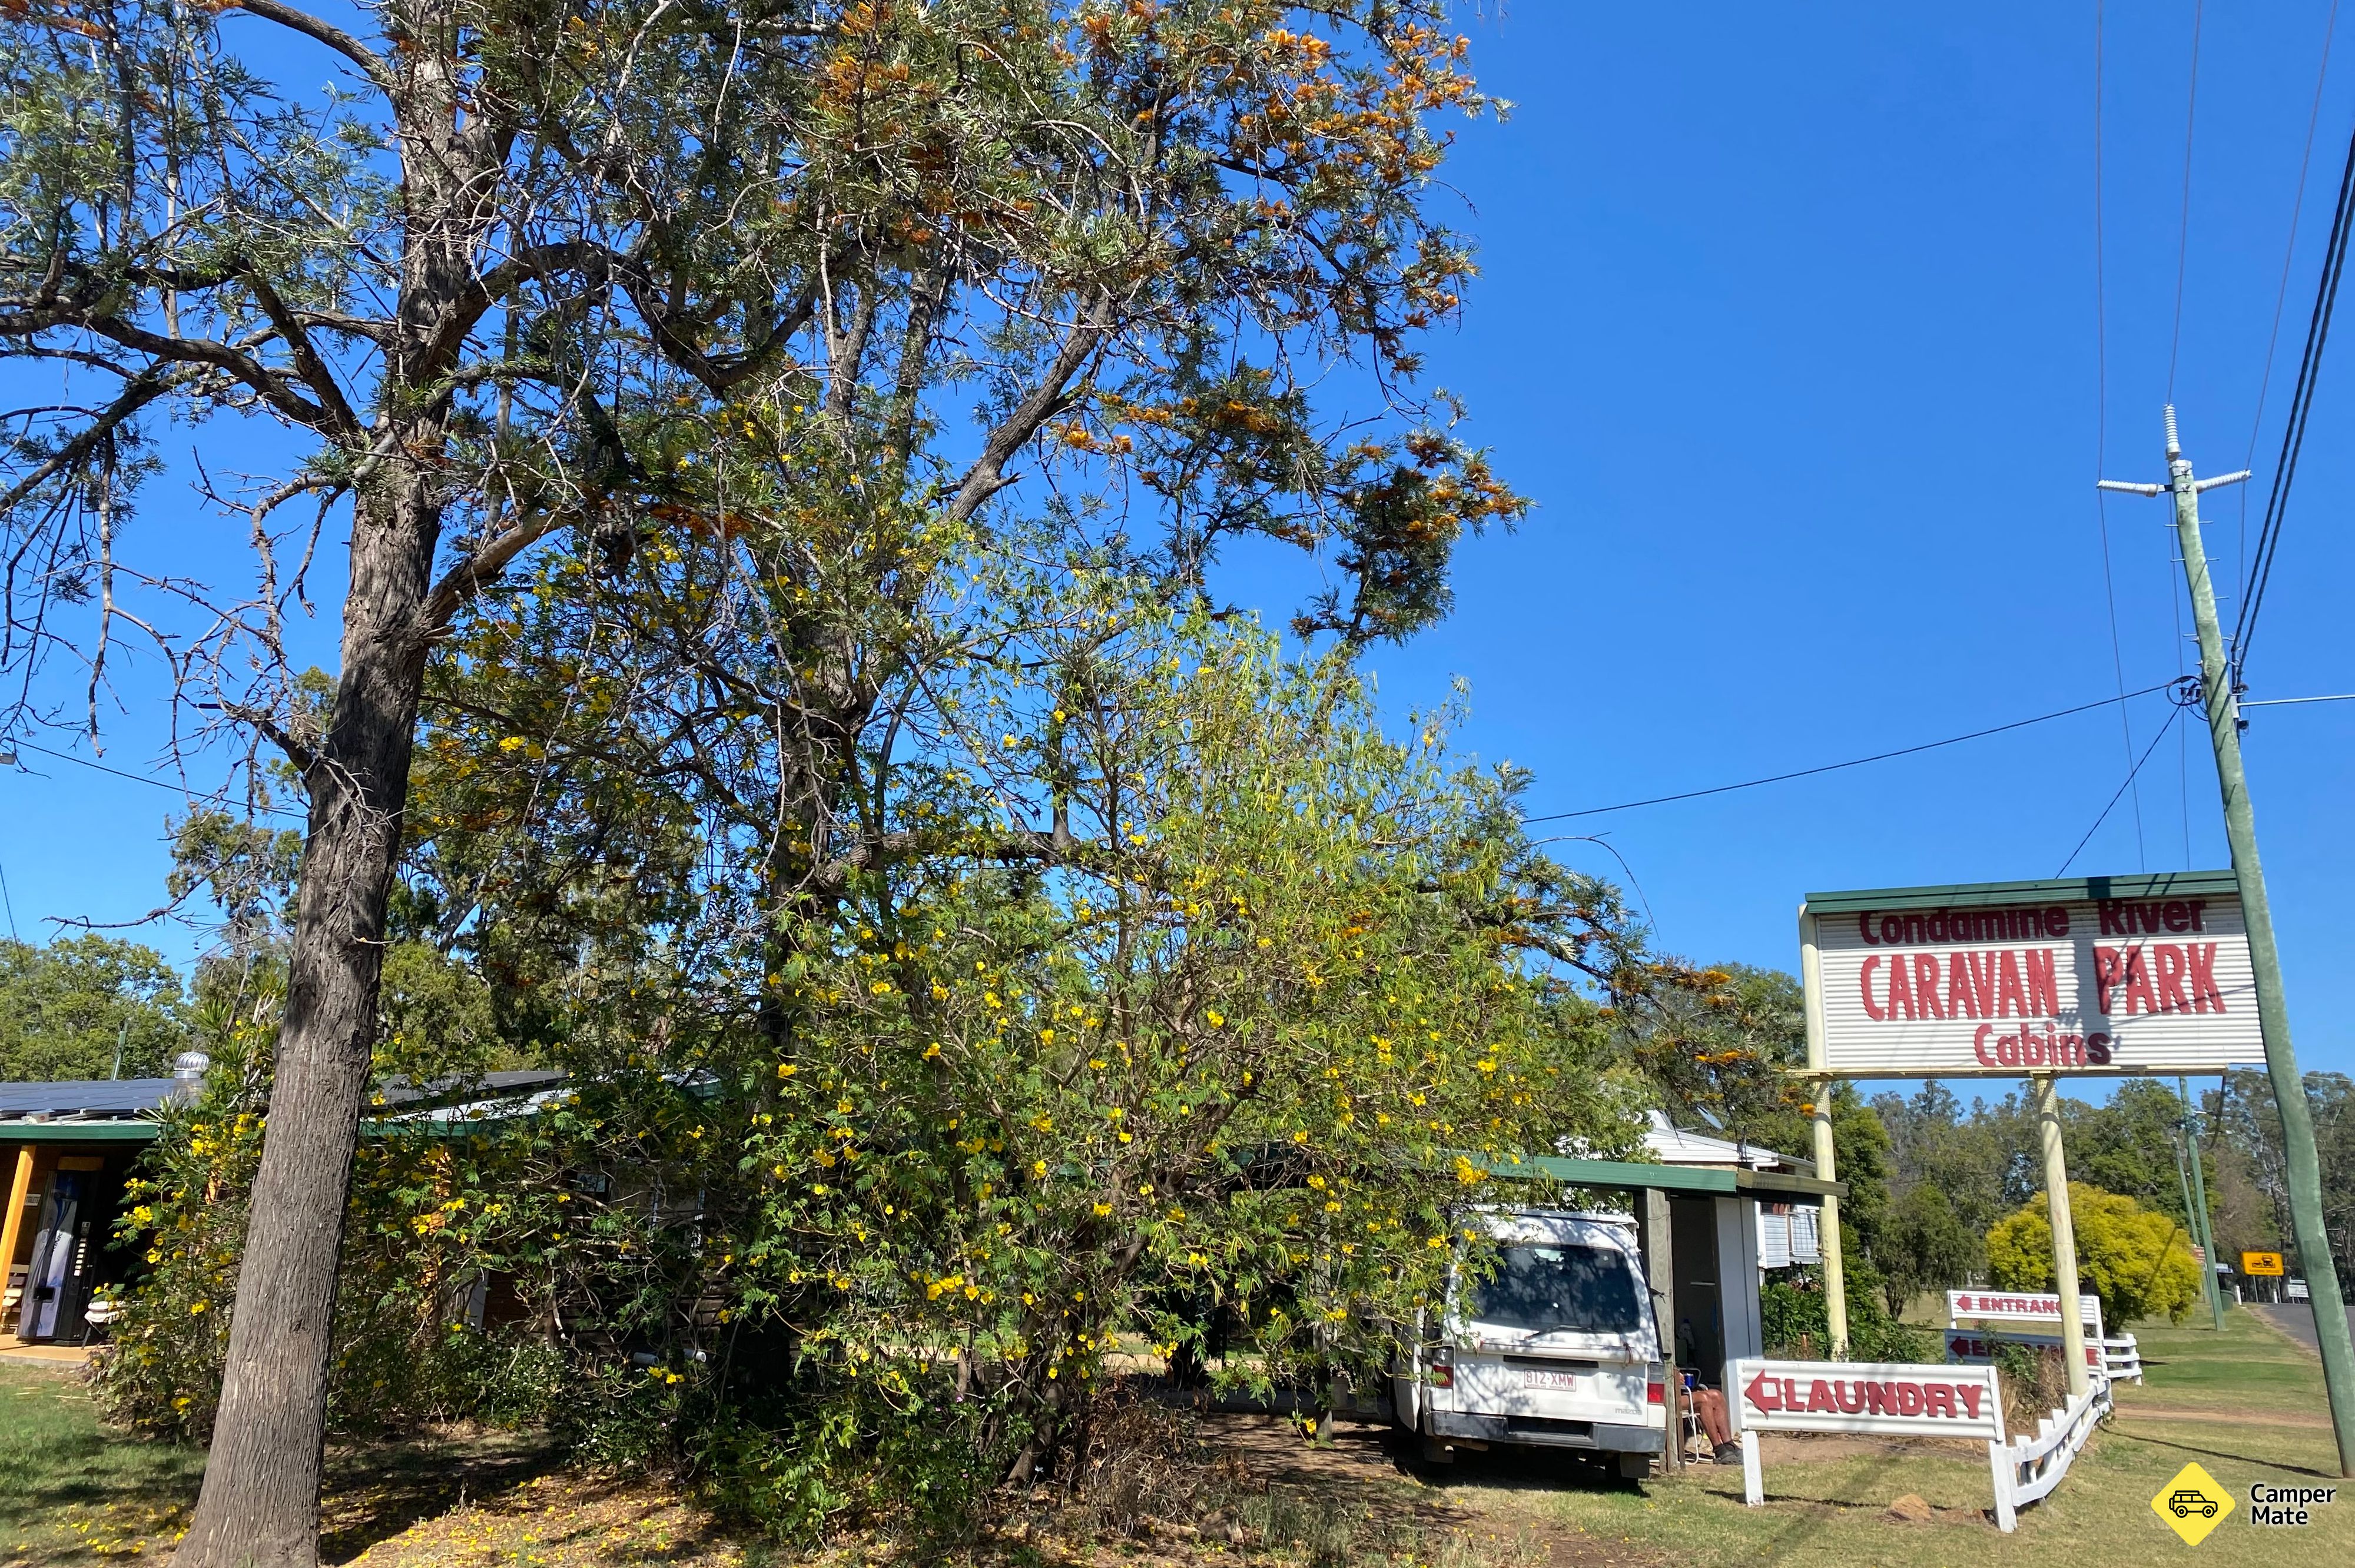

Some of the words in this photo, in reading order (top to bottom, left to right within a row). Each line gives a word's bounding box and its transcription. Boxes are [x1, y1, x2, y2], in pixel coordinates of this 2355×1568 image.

[1860, 907, 2069, 945] Condamine
[2098, 898, 2206, 935] River
[1860, 949, 2060, 1021] CARAVAN
[2093, 942, 2227, 1015] PARK
[1974, 1023, 2111, 1066] Cabins
[1785, 1378, 1983, 1419] LAUNDRY
